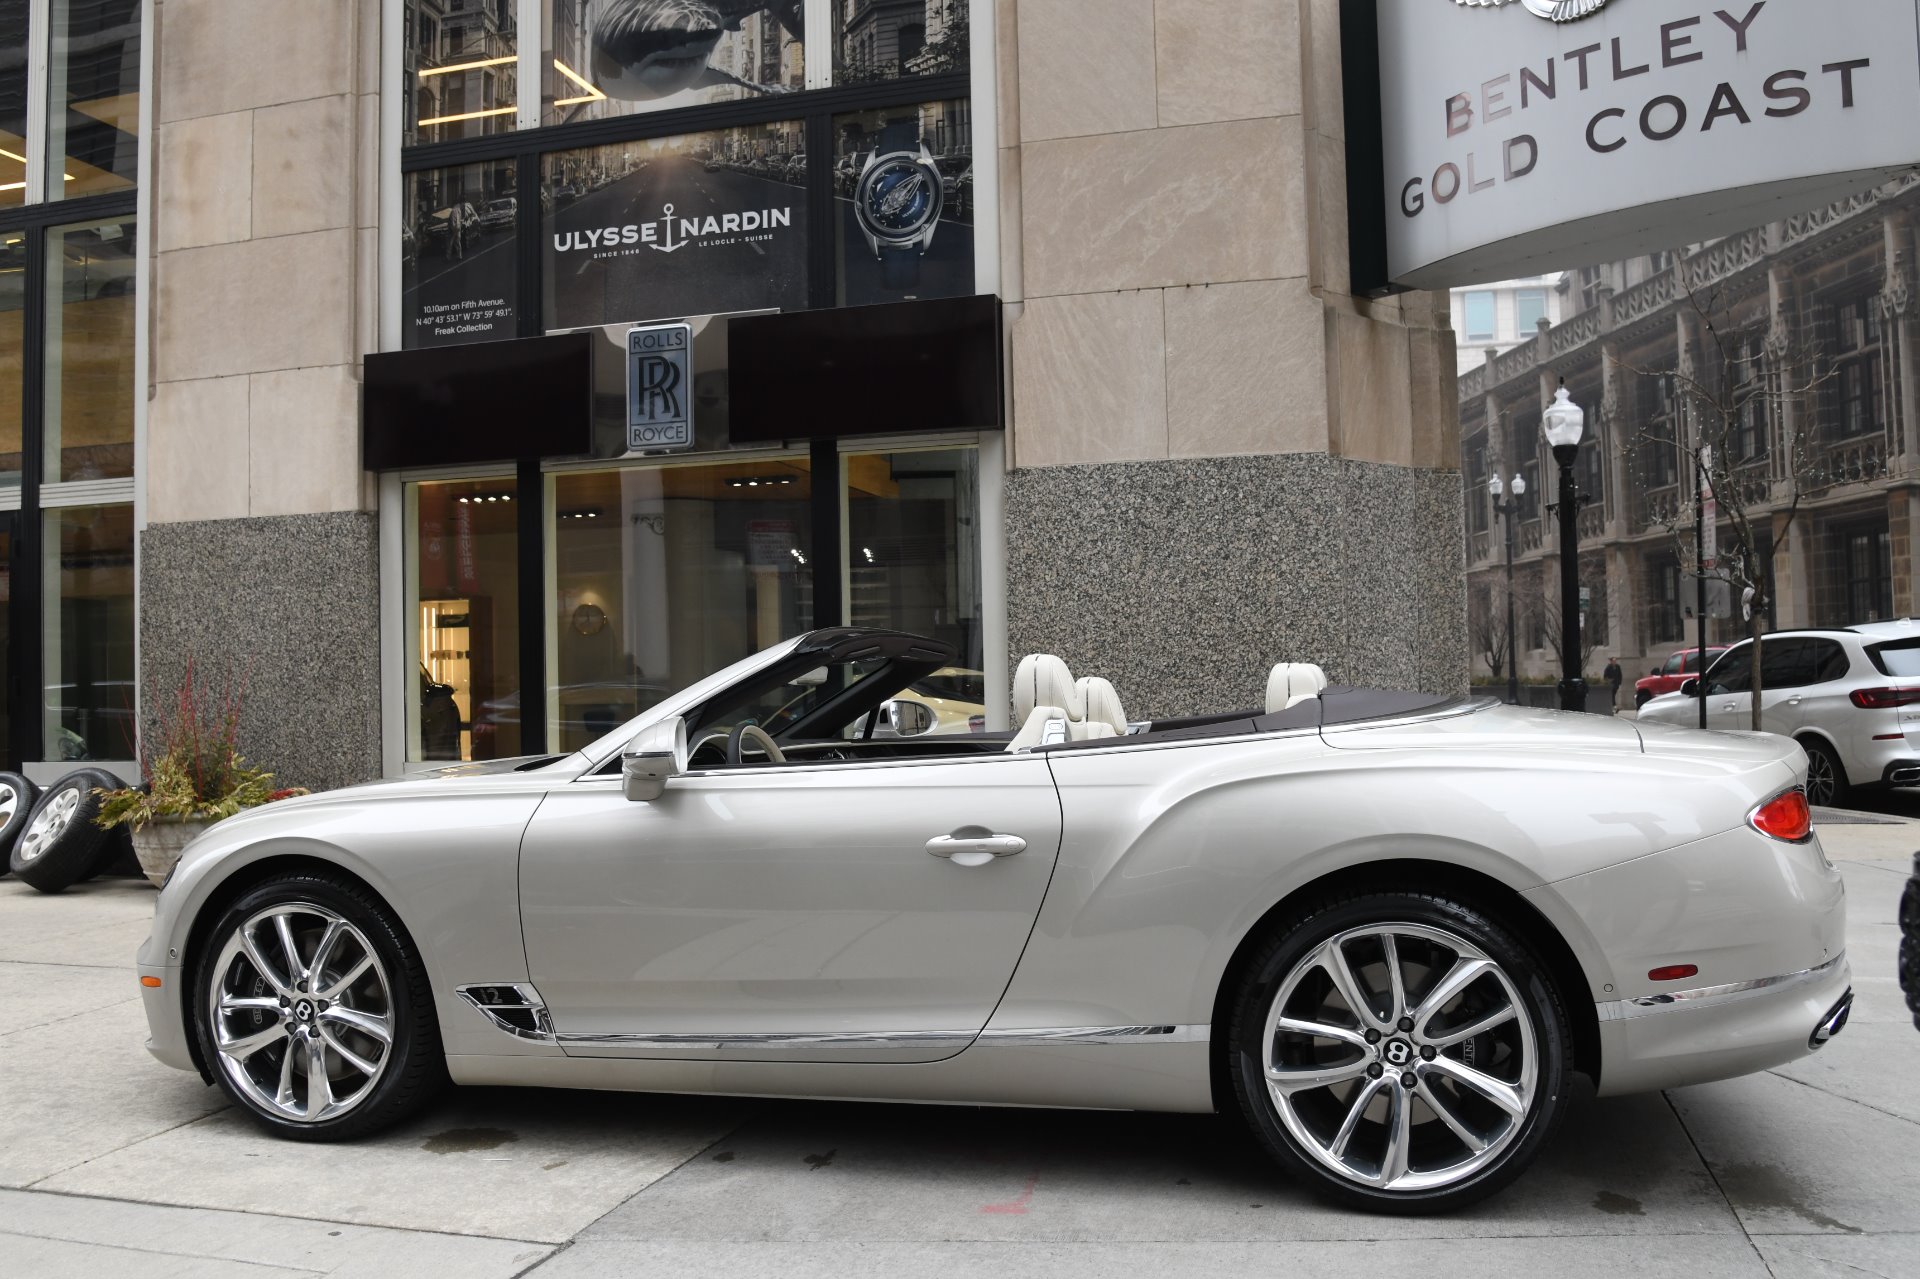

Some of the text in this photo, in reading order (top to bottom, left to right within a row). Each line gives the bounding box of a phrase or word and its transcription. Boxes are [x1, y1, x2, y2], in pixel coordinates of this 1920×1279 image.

[1445, 1, 1766, 139] BENTLEY
[1401, 57, 1870, 218] GOLD COAST
[553, 207, 791, 252] ULYSSE NARDIN
[711, 238, 735, 246] LOCLE
[745, 234, 774, 243] SUISSE
[593, 248, 640, 259] SINCE 1846
[424, 299, 505, 314] 10.10am on Fifth Avenue.
[416, 318, 422, 326] N
[463, 312, 471, 321] W
[435, 323, 493, 336] Freak Collection
[633, 331, 682, 350] ROLLS
[633, 425, 684, 442] ROYCE
